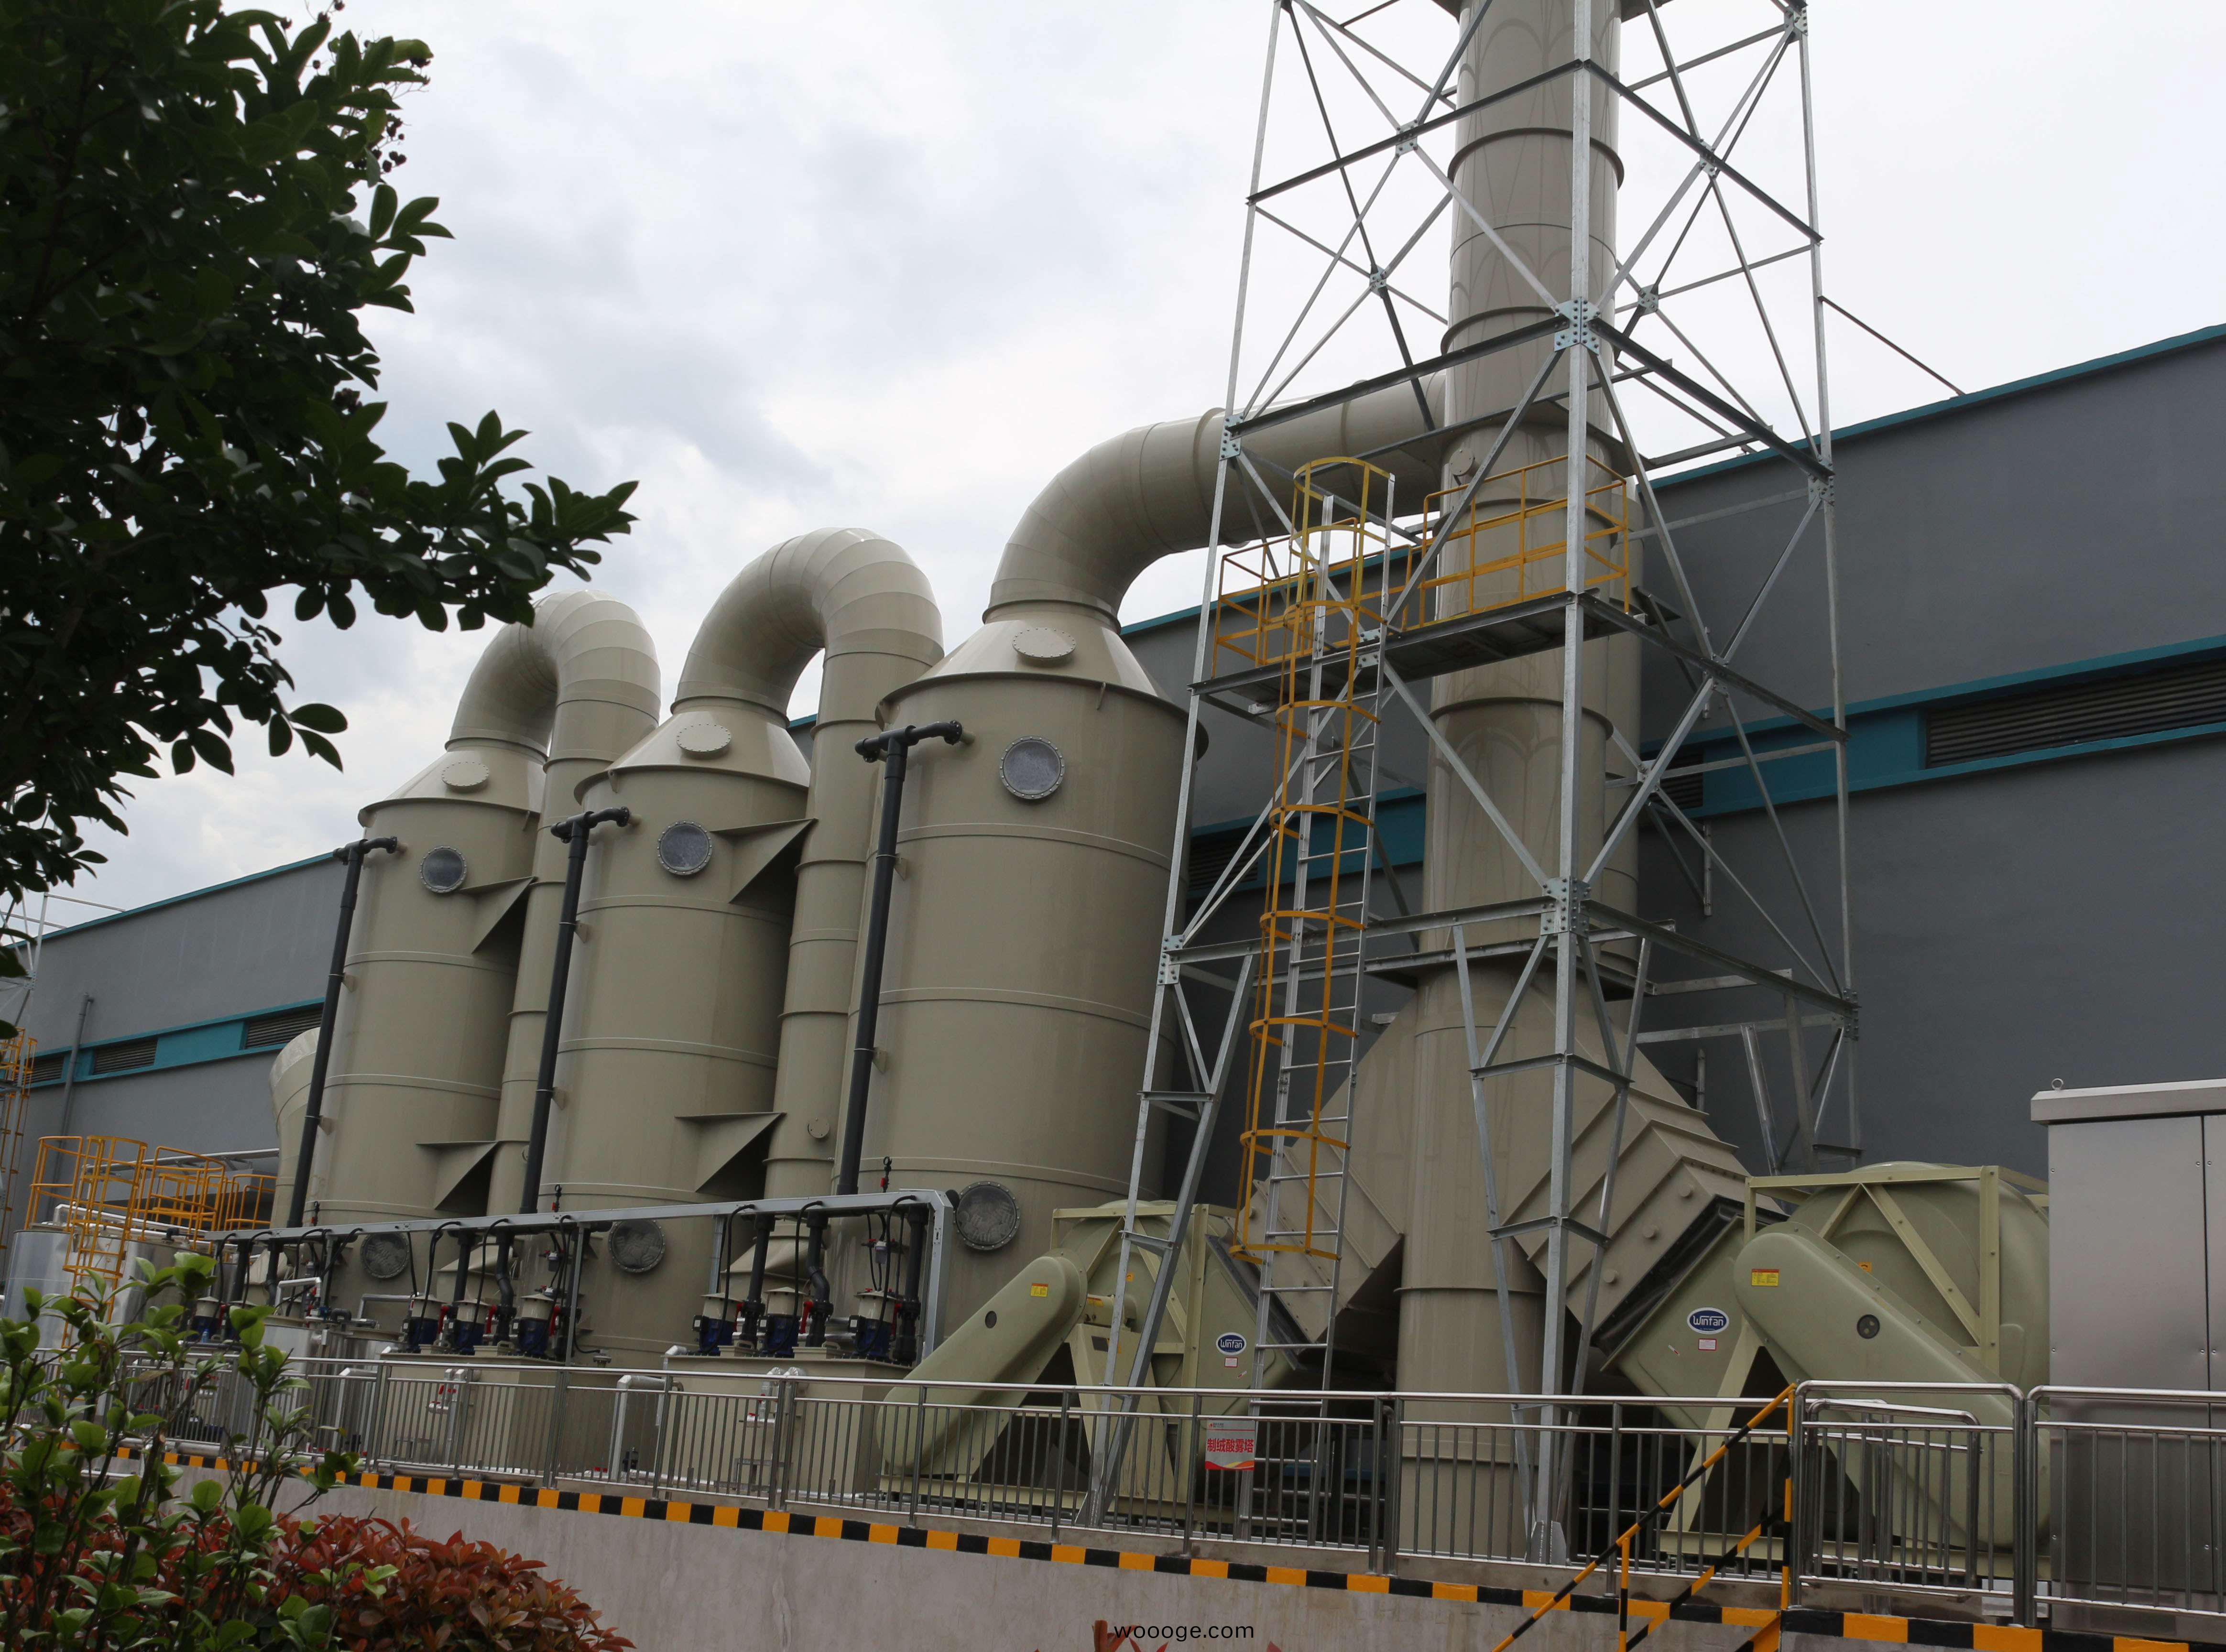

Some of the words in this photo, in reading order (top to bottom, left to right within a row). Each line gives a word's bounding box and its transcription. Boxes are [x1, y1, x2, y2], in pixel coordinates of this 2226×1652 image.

[1207, 1438, 1254, 1453] 制绒酸雾塔
